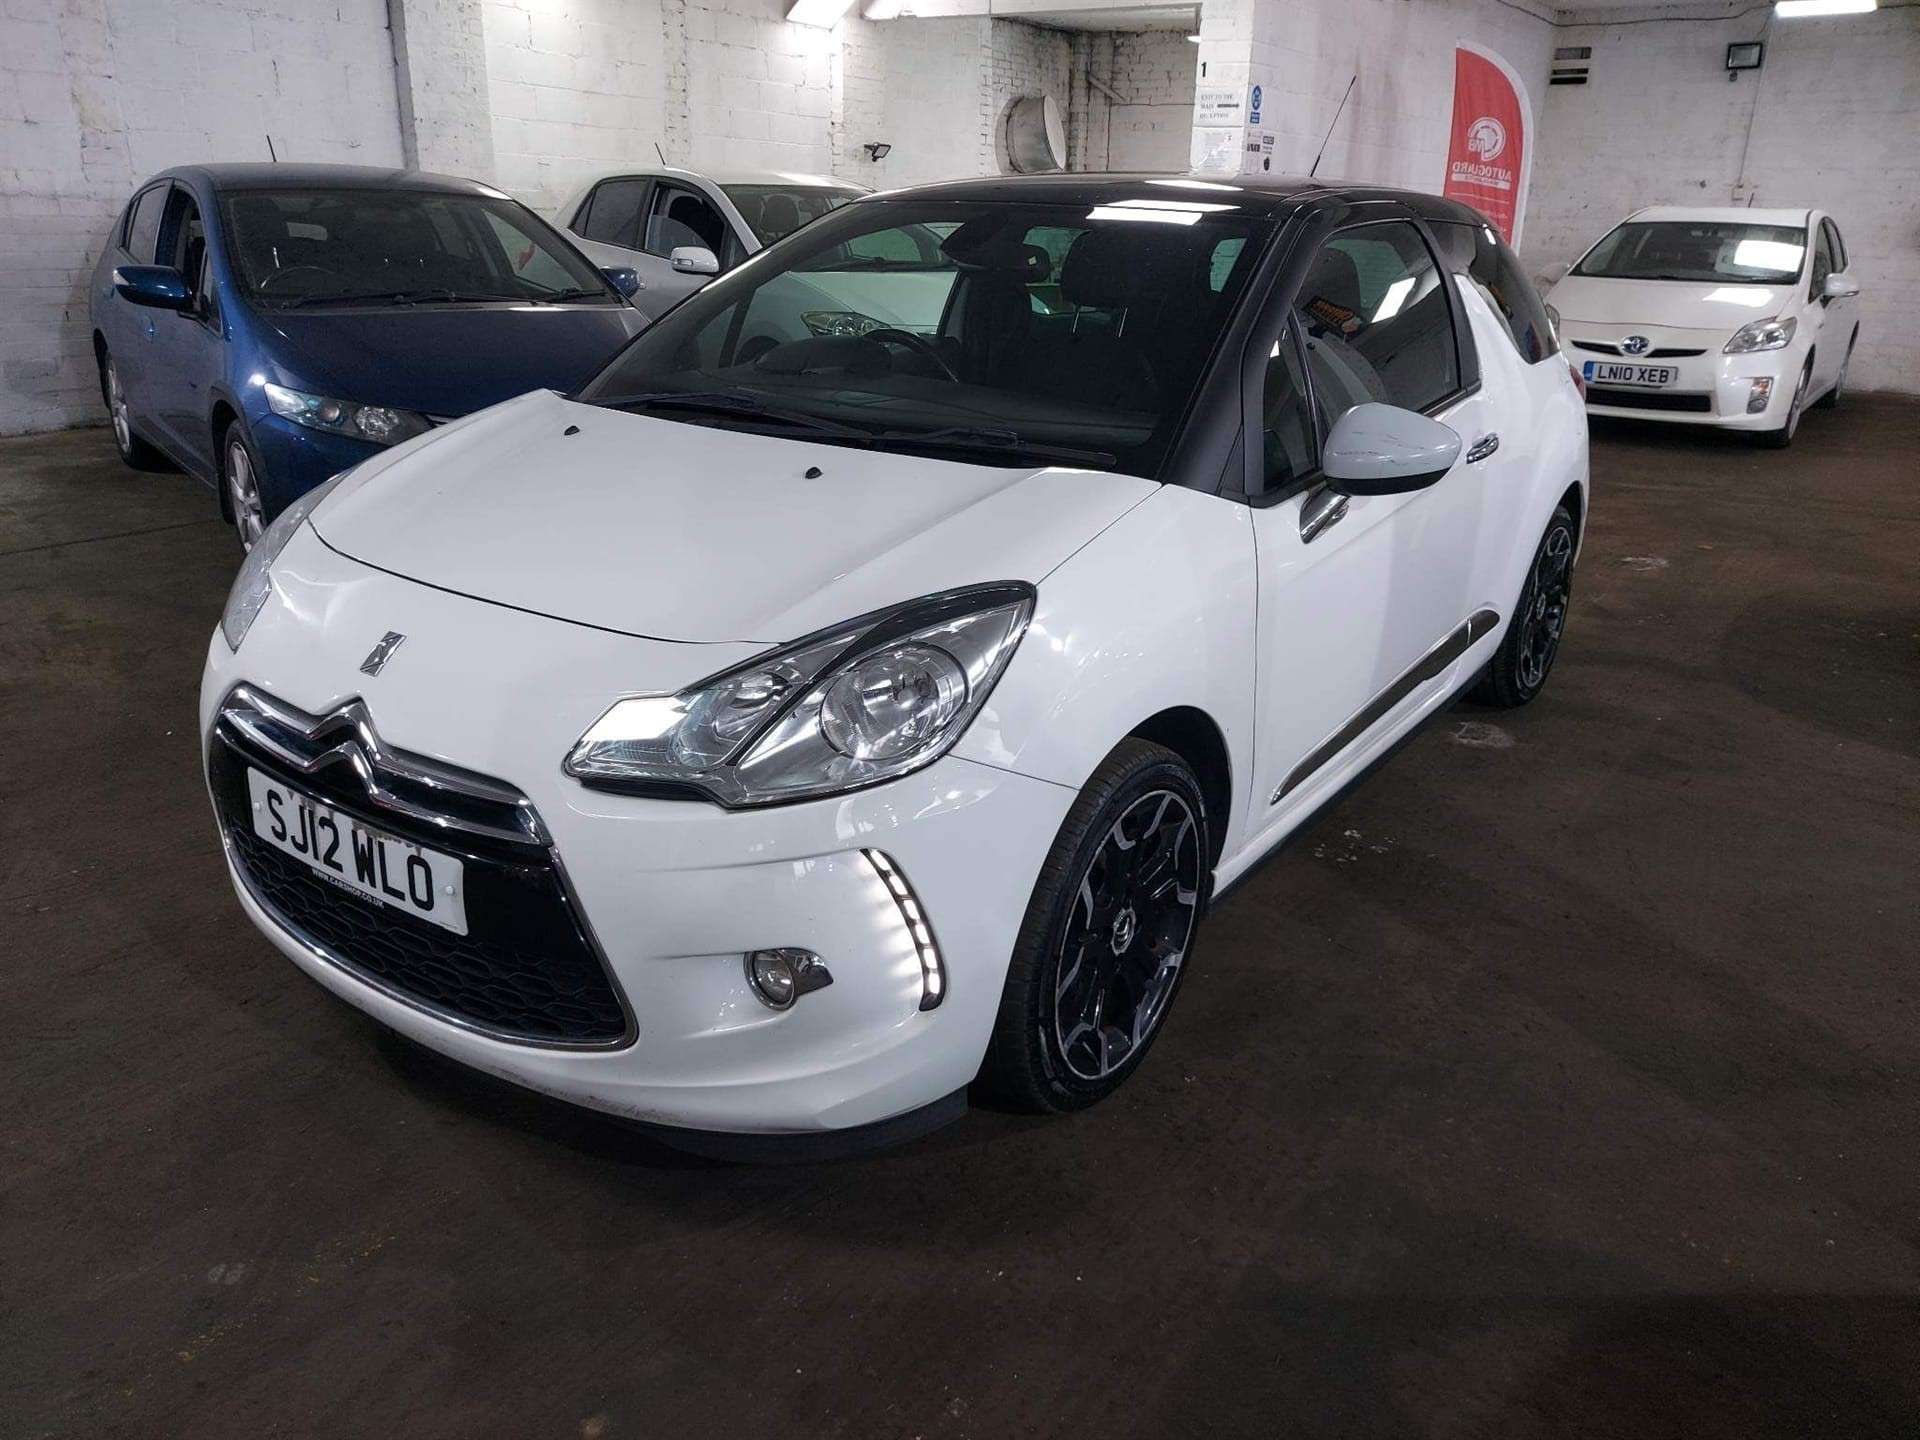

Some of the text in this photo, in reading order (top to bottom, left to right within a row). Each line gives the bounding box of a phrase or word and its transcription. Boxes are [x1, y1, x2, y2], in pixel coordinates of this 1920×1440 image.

[1201, 61, 1207, 78] 1
[1597, 364, 1669, 383] LN10 XEB
[267, 788, 435, 912] SJ12 WLO
